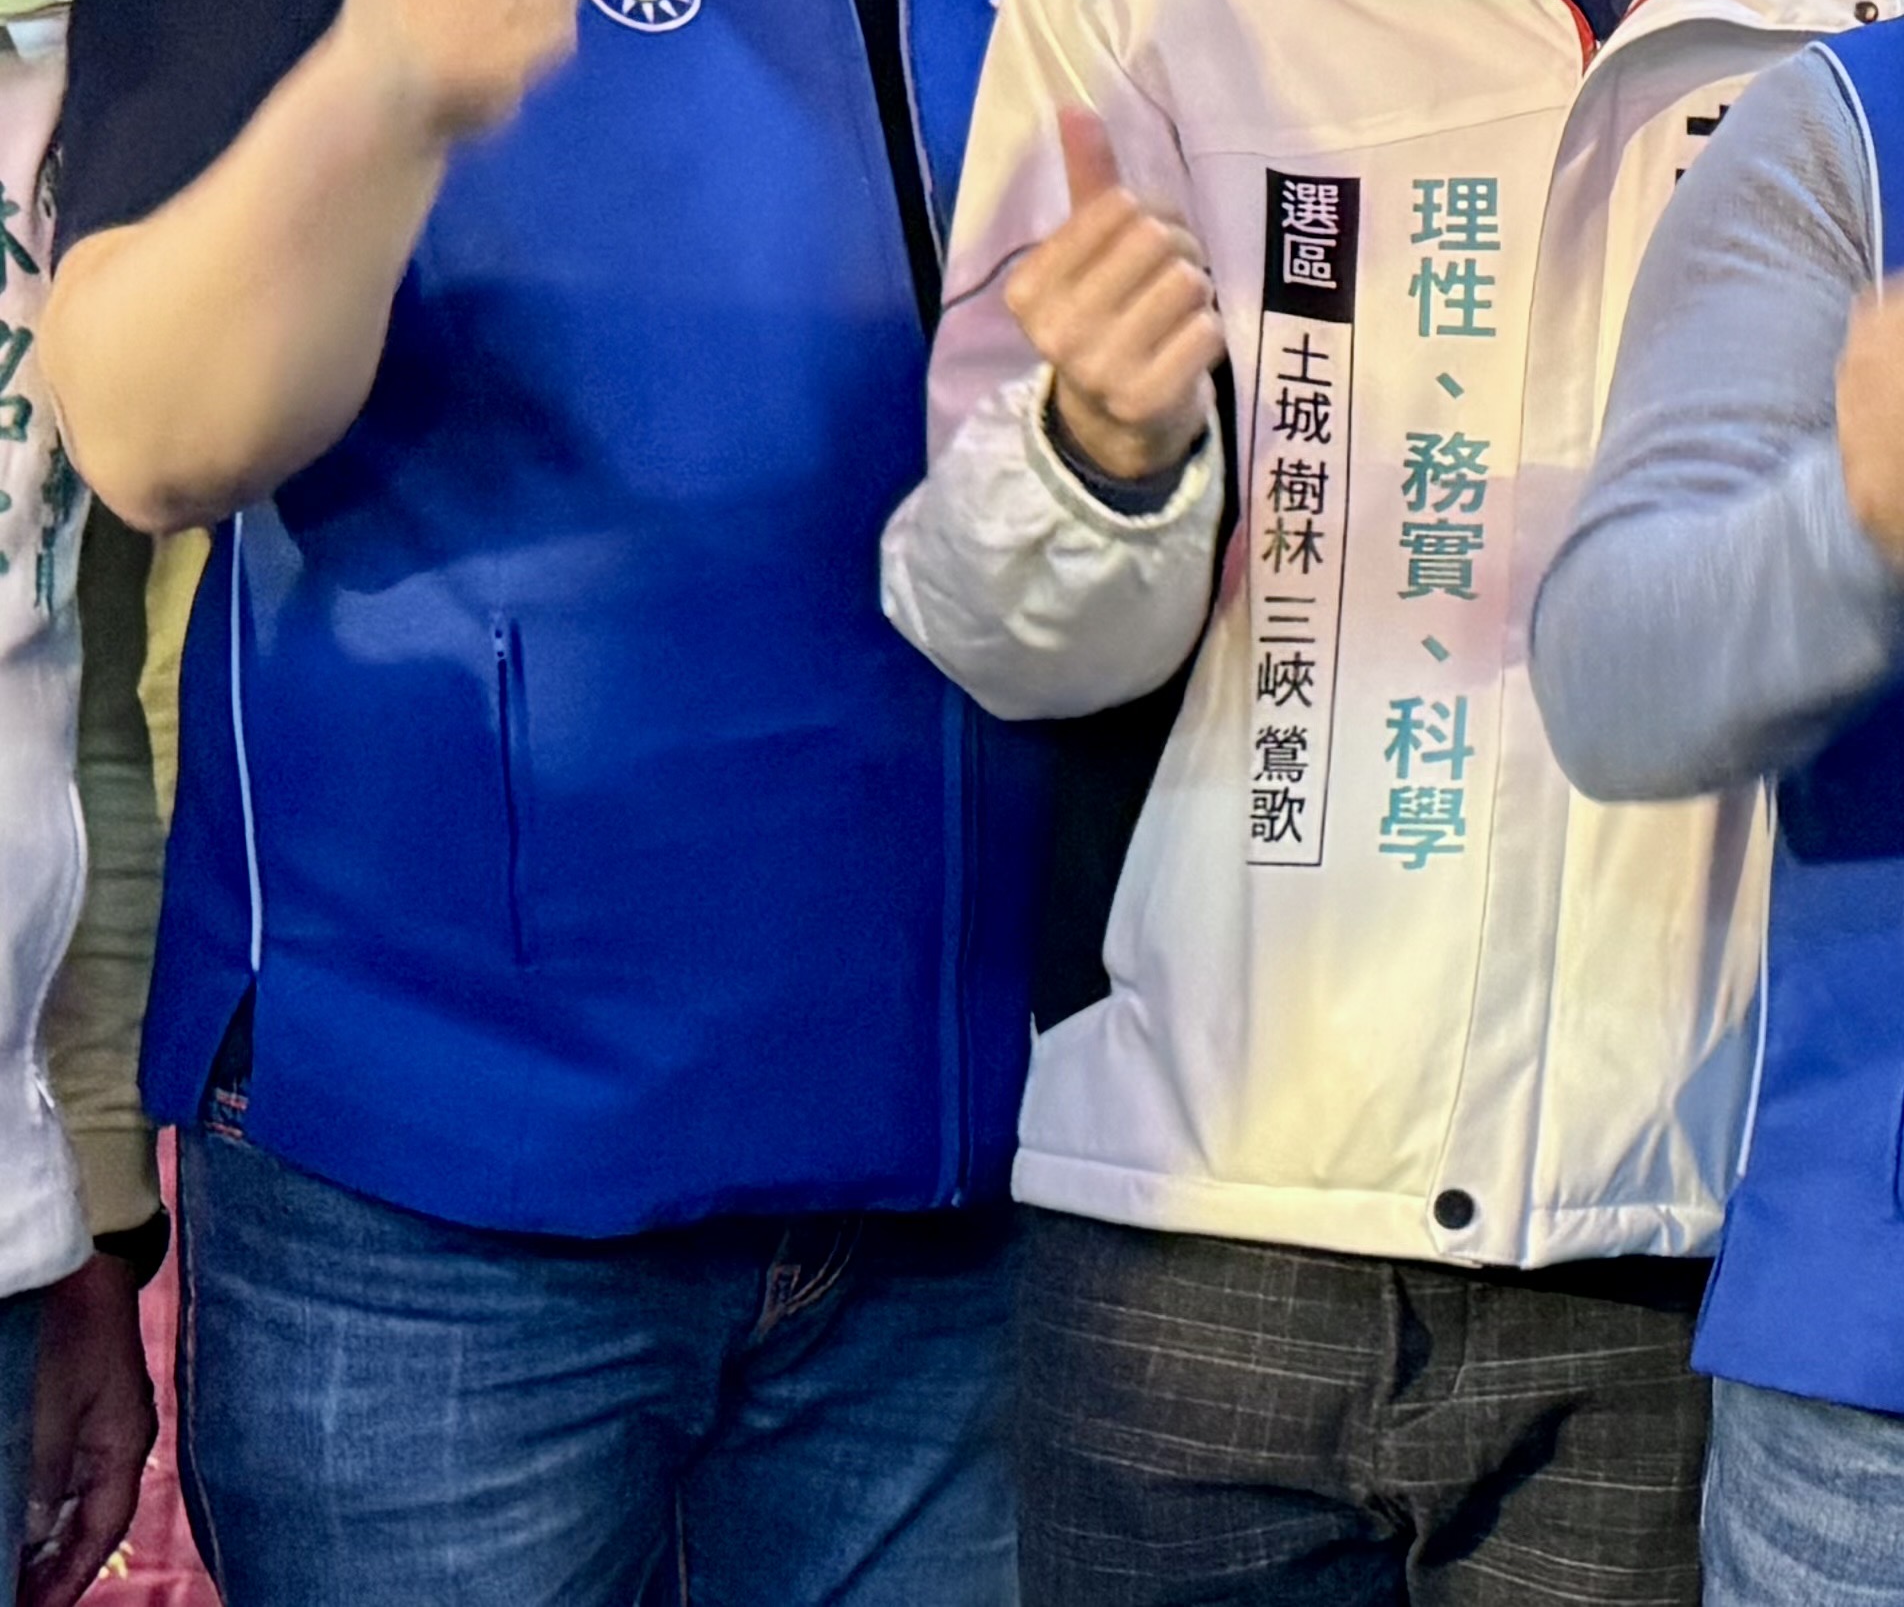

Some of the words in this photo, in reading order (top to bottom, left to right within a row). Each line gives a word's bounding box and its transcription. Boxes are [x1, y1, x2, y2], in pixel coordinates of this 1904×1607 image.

[1281, 180, 1339, 290] 選區
[1272, 333, 1333, 445] 土城
[1260, 457, 1329, 577] 樹林
[1256, 595, 1318, 708] 三峽
[1249, 725, 1309, 844] 鶯歌
